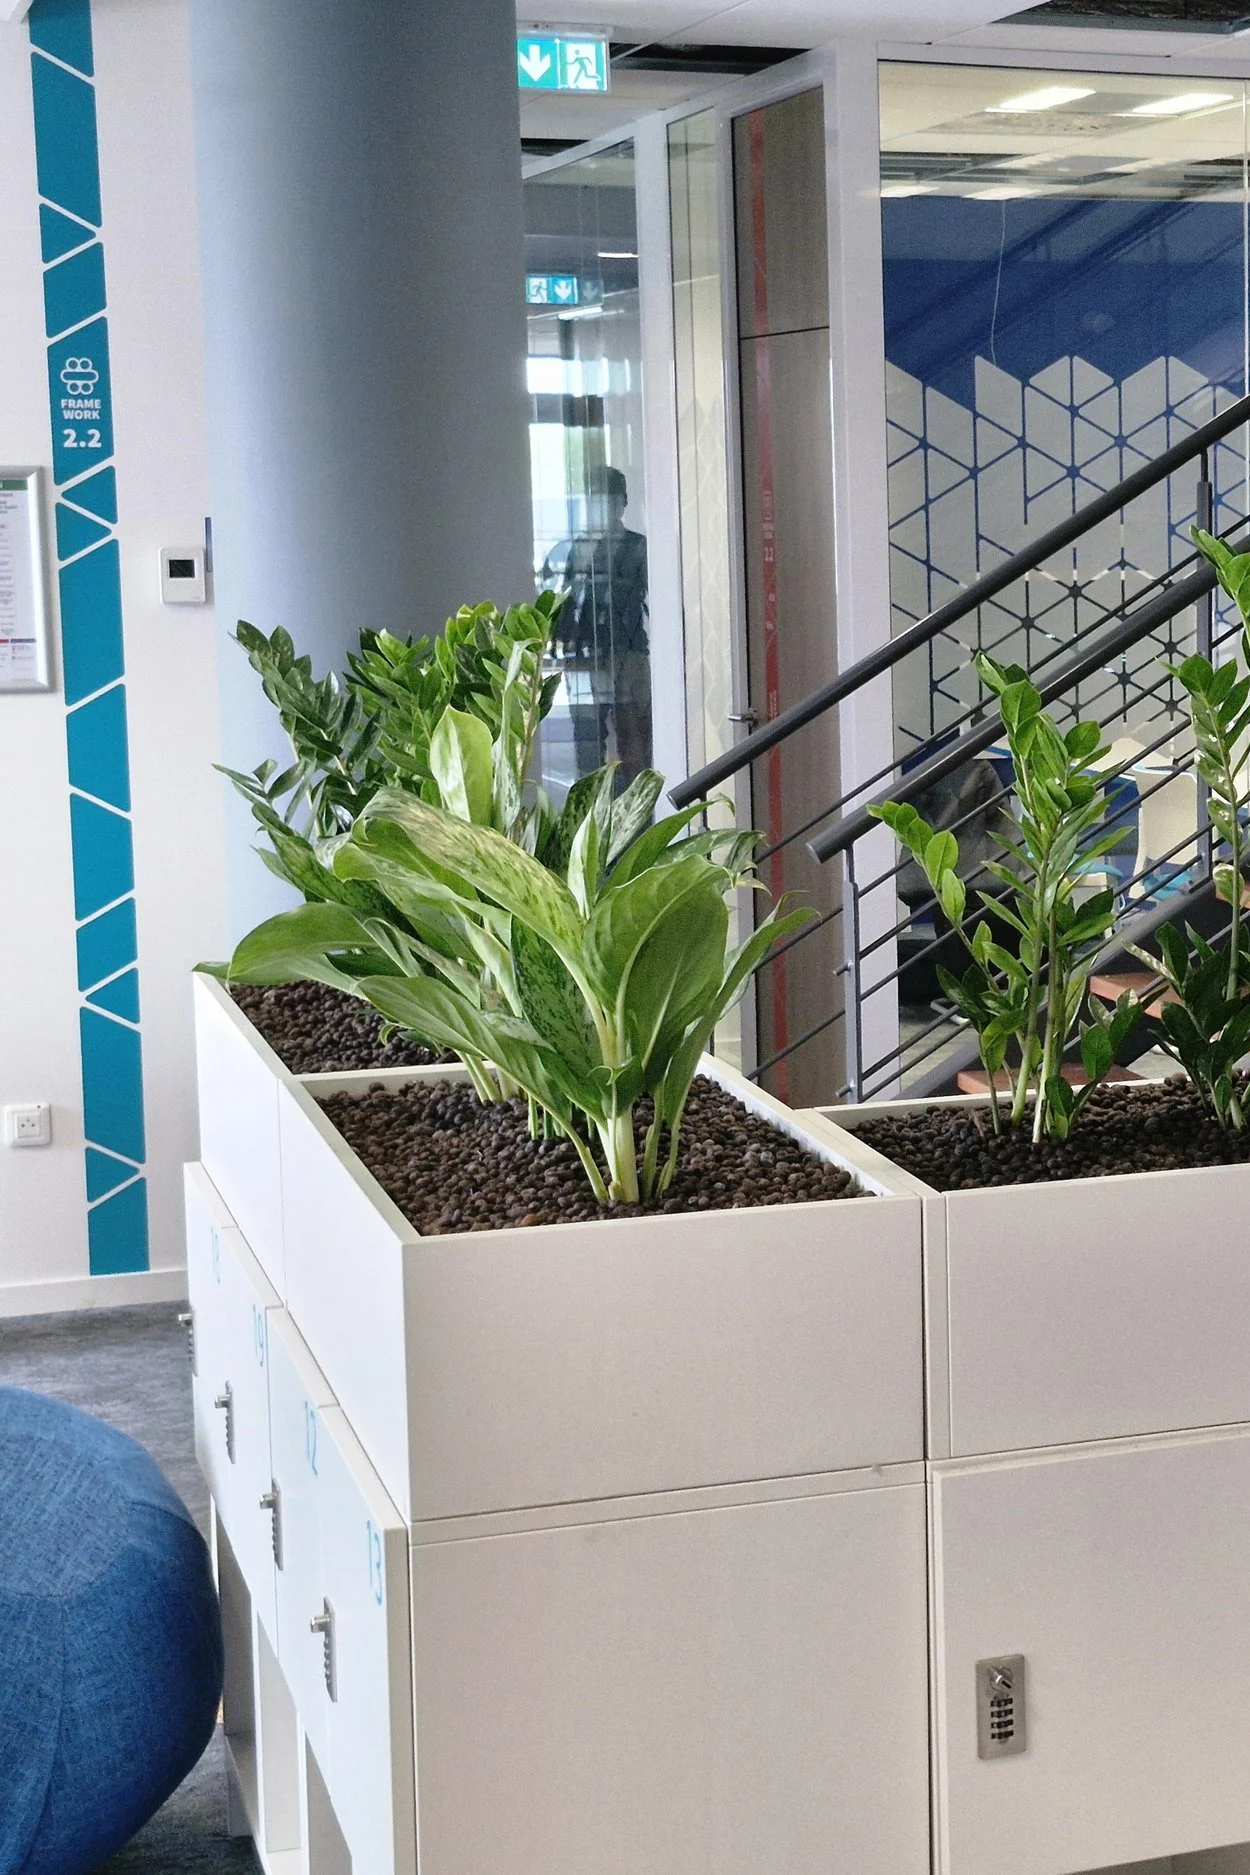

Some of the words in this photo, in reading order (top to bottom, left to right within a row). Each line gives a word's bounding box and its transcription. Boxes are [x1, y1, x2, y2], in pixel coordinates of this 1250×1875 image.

[61, 399, 101, 409] FRAME
[63, 410, 100, 420] WORK
[63, 428, 102, 448] 2.2
[303, 1400, 319, 1477] 12
[366, 1520, 383, 1606] 13
